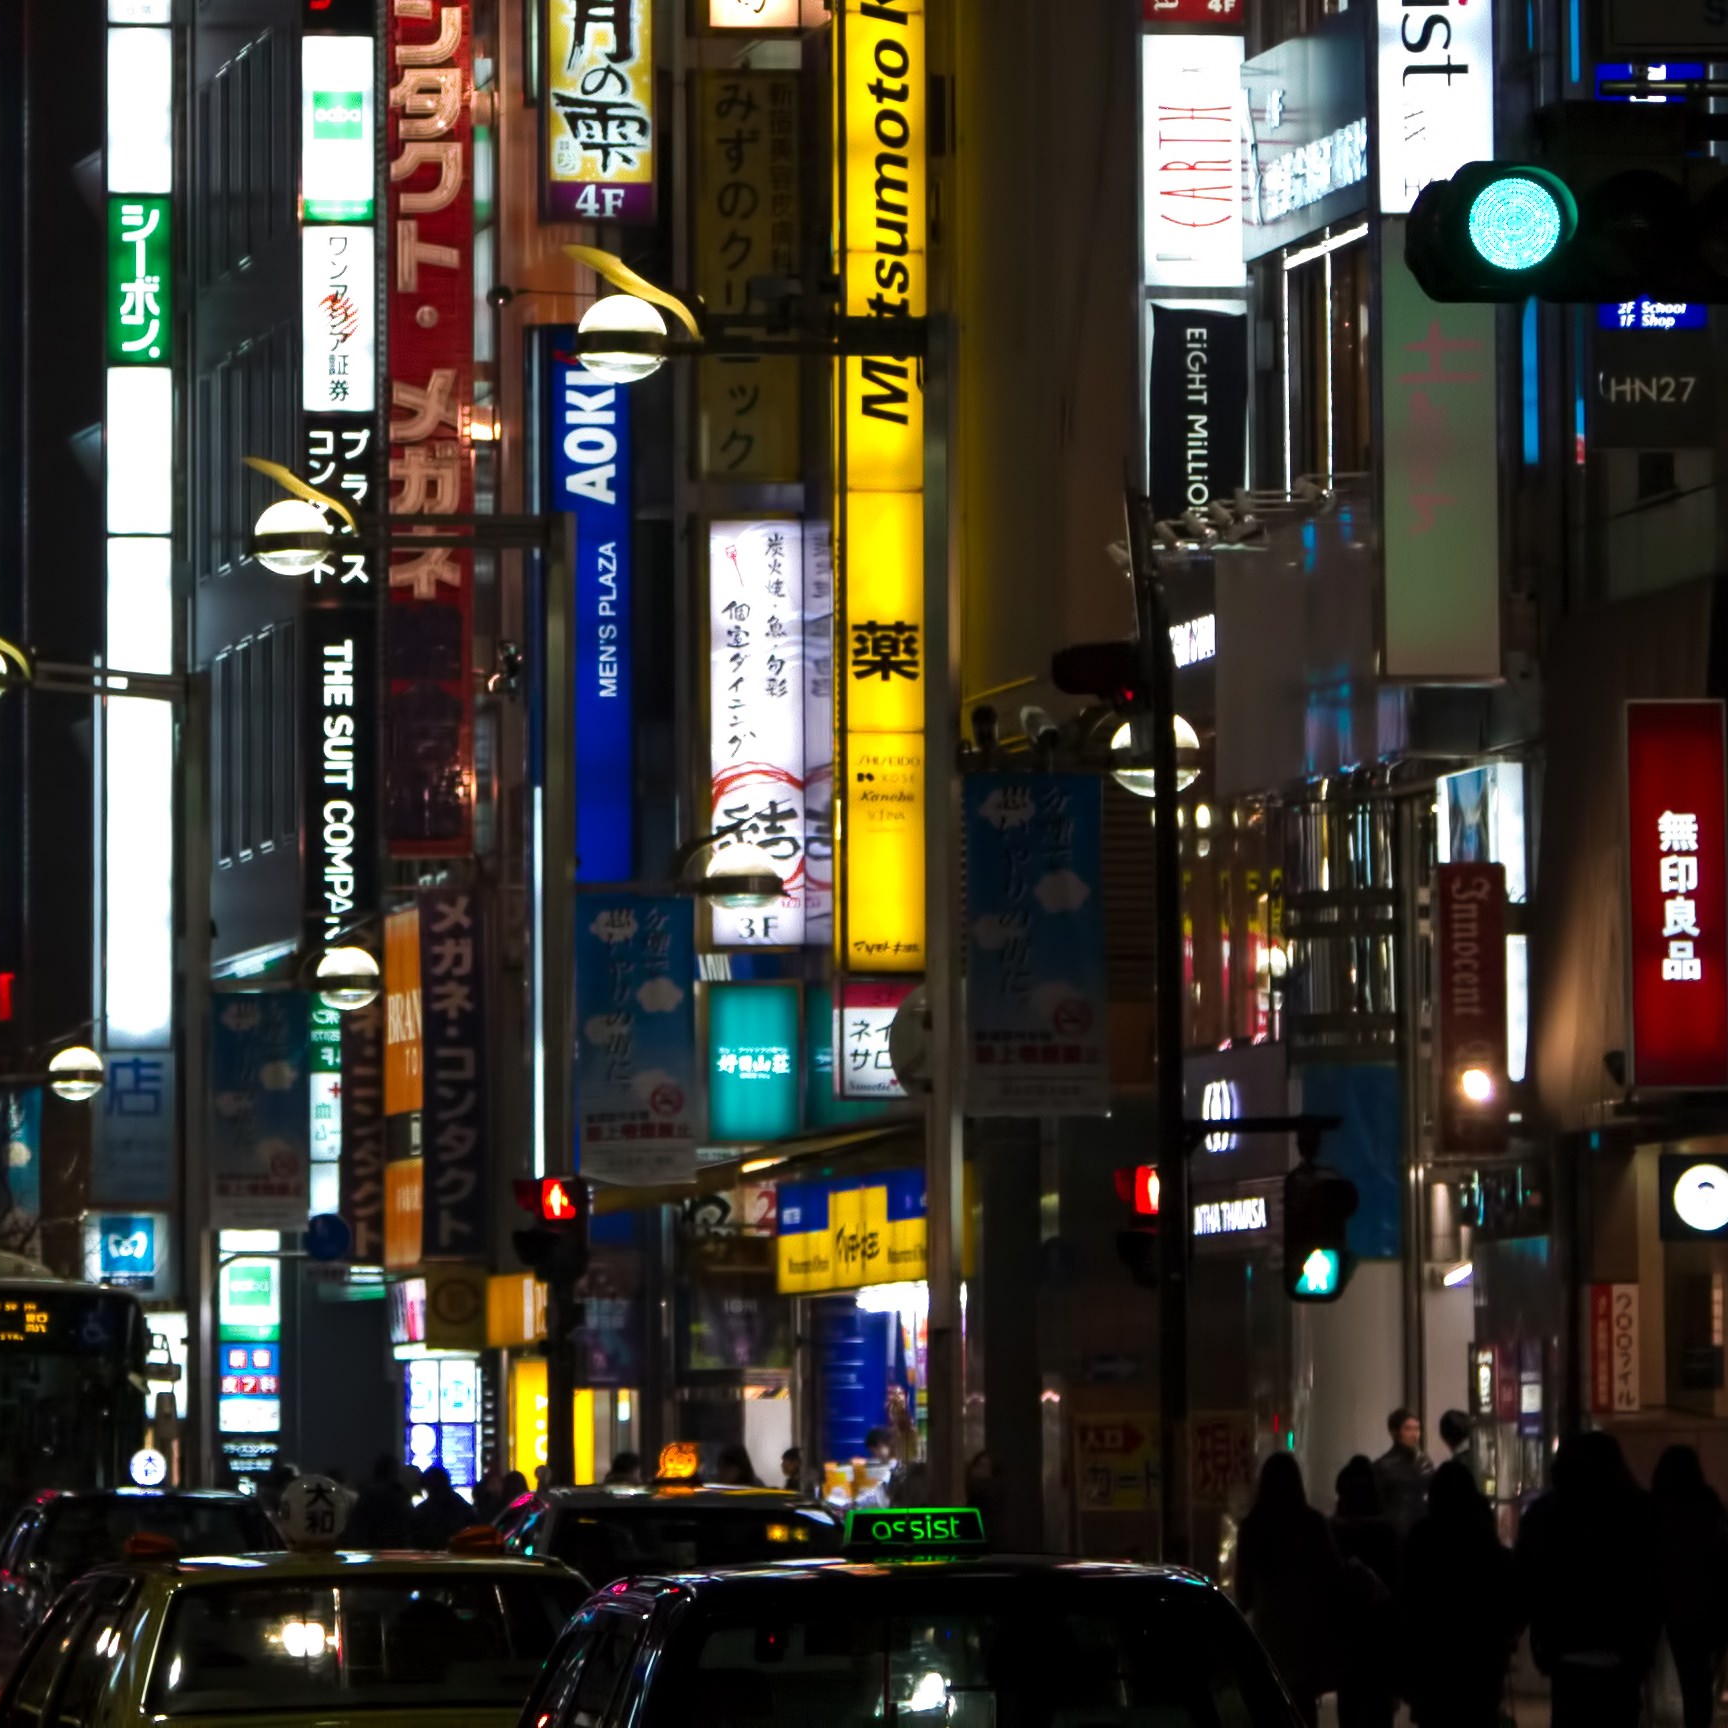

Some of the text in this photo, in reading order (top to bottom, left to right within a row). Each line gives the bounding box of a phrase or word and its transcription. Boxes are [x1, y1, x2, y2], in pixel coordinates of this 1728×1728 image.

[575, 187, 625, 218] 4F
[599, 541, 618, 698] MEN'S PLAZA
[851, 621, 920, 682] 薬
[323, 639, 354, 706] THE
[323, 715, 354, 790] SUIT
[739, 915, 779, 939] 3F
[1657, 810, 1702, 982] 無印良品
[872, 1515, 960, 1541] assist
